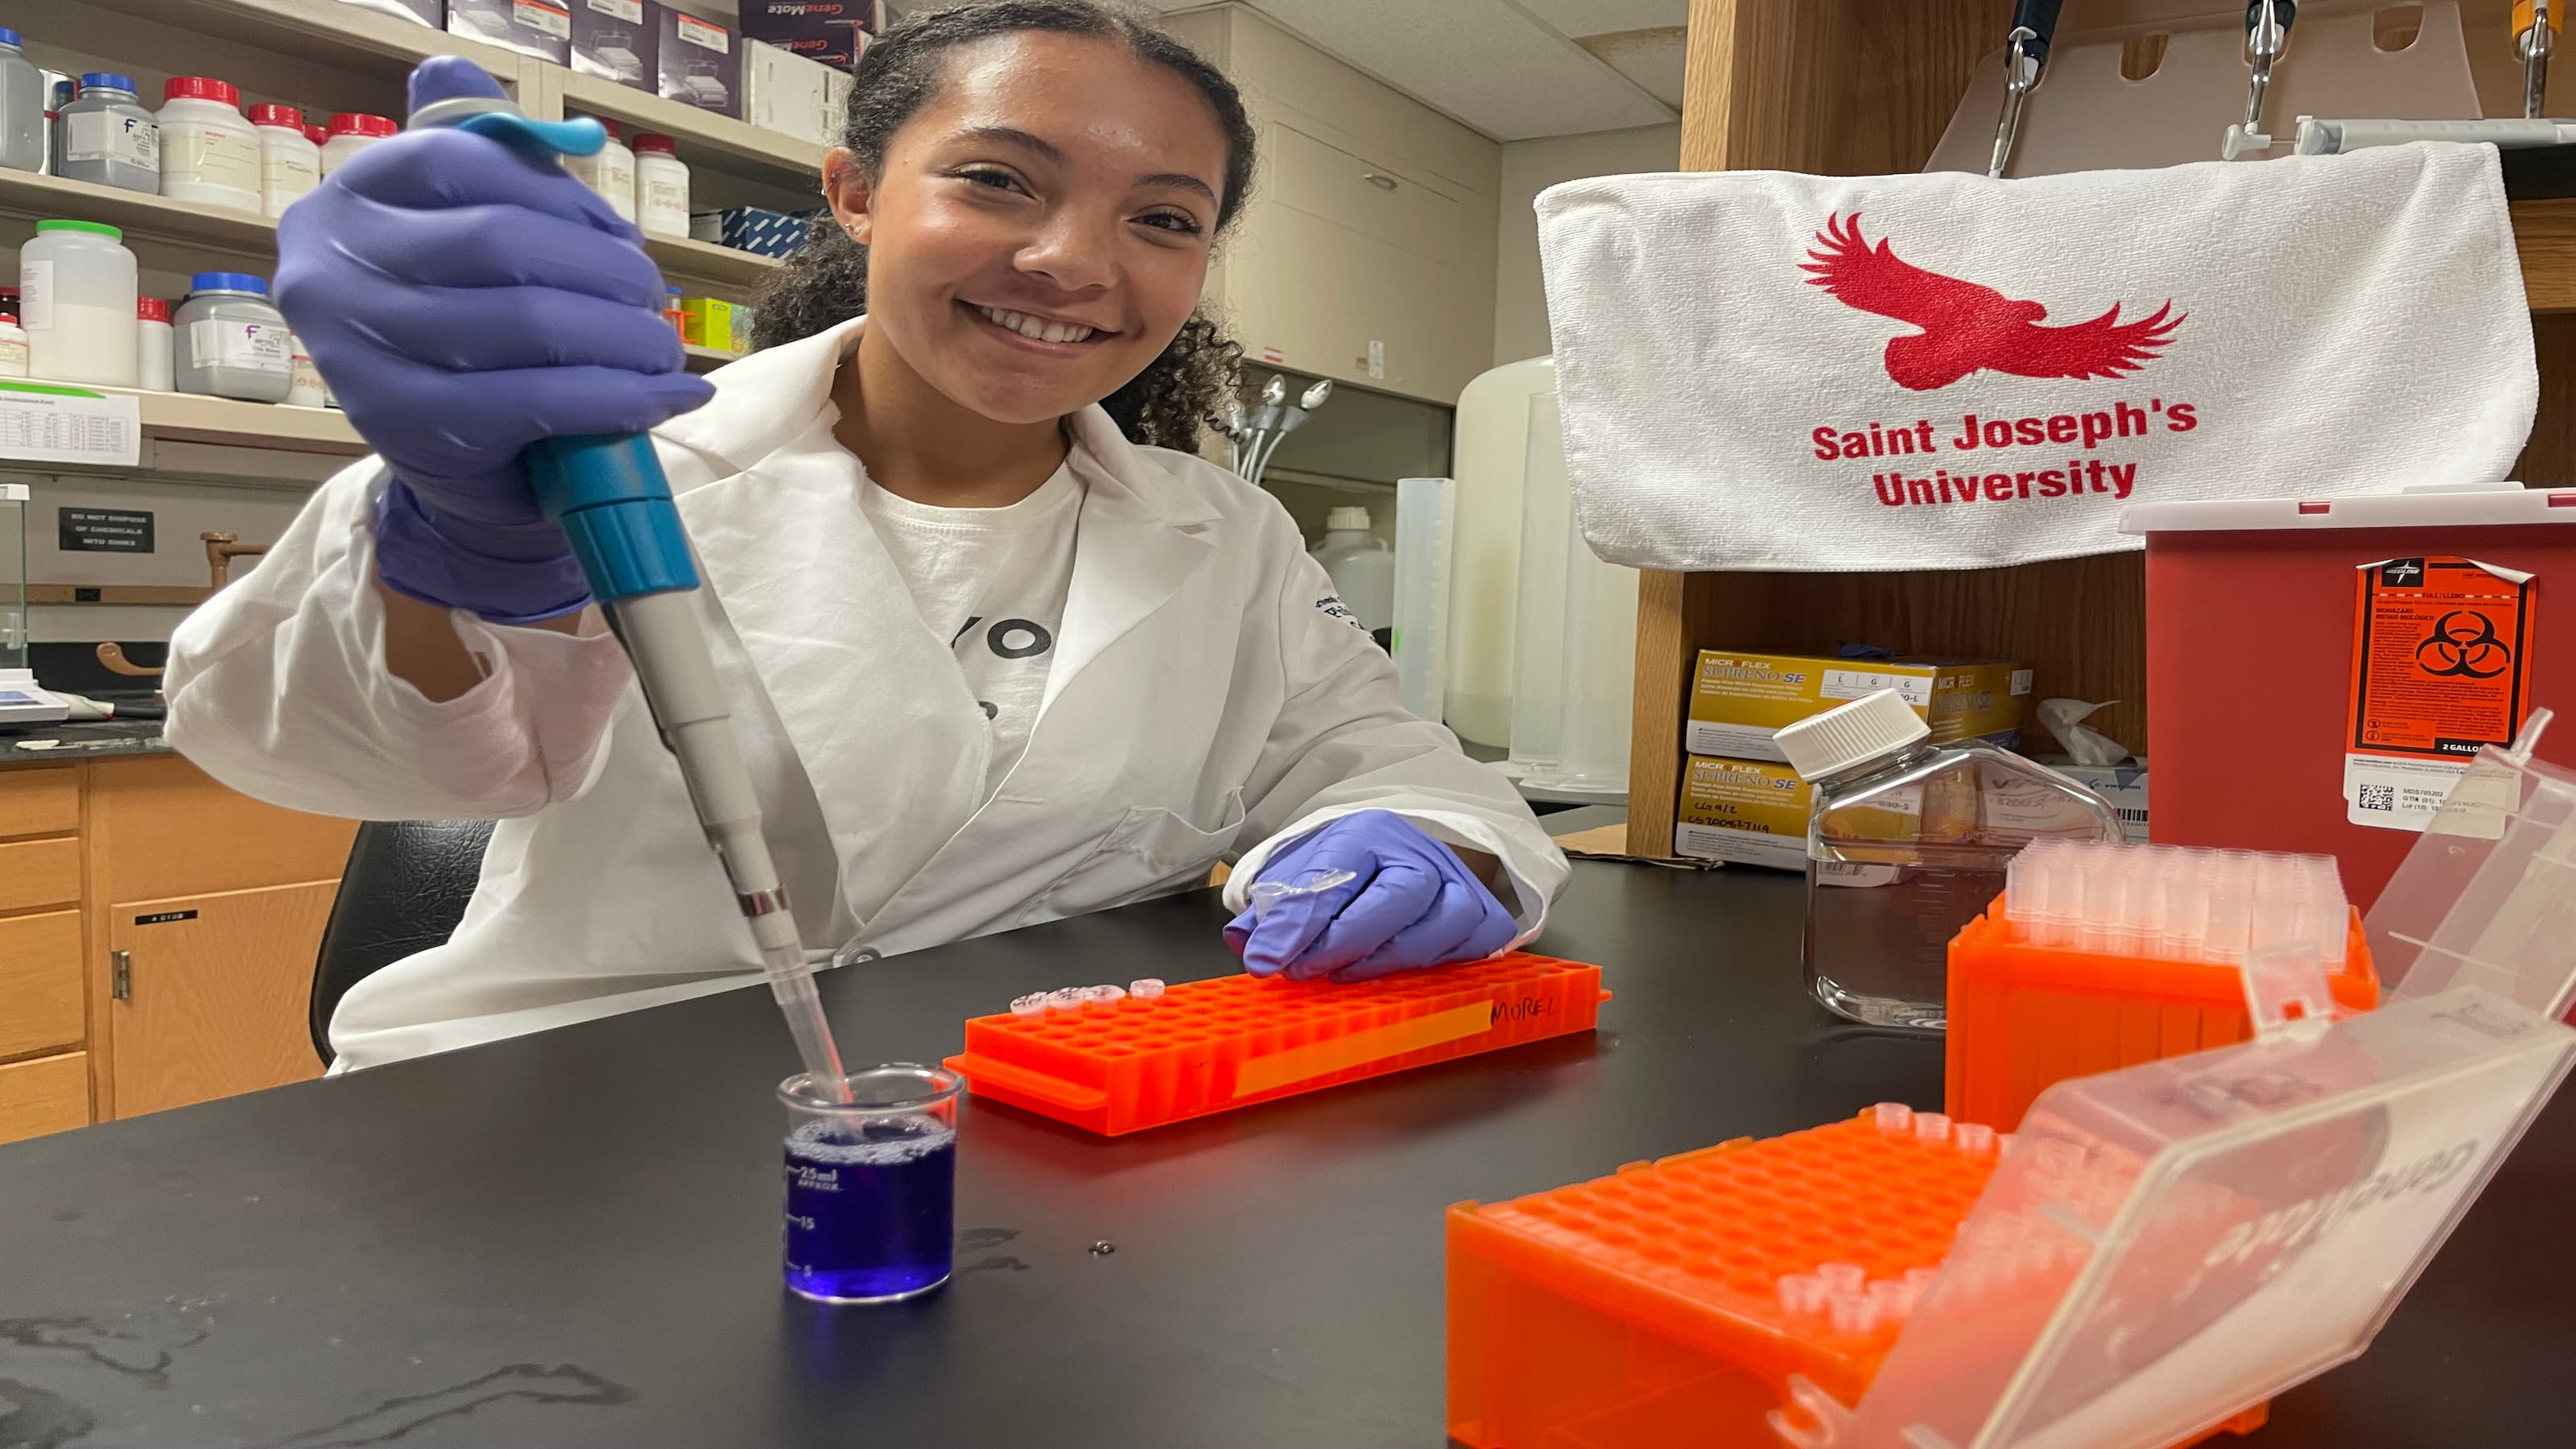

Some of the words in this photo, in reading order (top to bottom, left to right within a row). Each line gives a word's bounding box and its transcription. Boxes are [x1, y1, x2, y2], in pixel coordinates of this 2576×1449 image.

[767, 3, 844, 14] GeneMate
[124, 118, 138, 133] F
[245, 324, 261, 339] F
[1812, 420, 1937, 460] Saint
[1954, 398, 2198, 450] Joseph's
[1872, 459, 2137, 506] University
[90, 526, 143, 535] CHEMICALS
[1783, 673, 1806, 683] SE
[1773, 778, 1797, 789] SE
